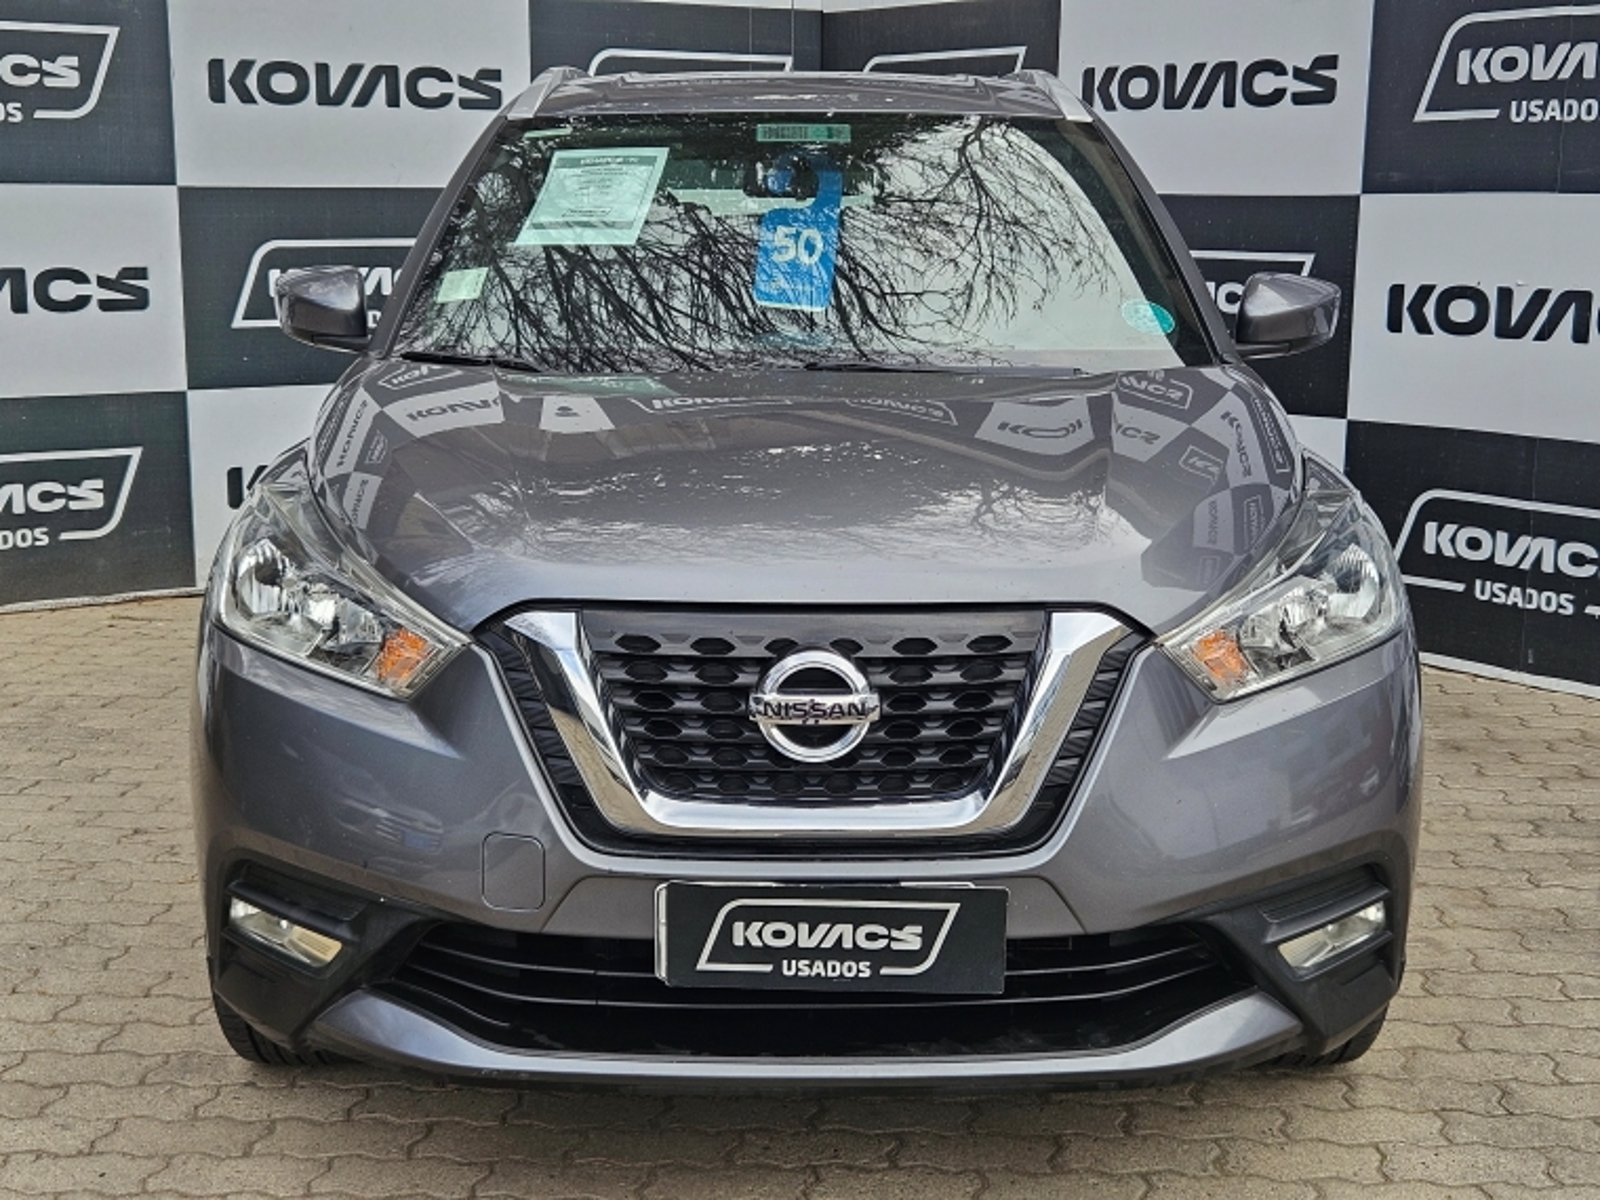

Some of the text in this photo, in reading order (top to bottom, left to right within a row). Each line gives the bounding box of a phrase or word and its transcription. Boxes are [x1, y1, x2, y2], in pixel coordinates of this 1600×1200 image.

[1456, 42, 1599, 85] KOVA
[208, 58, 503, 110] KOVACS
[1082, 54, 1339, 112] KOVACS
[1510, 98, 1599, 123] USADO
[772, 226, 823, 264] 50
[1387, 284, 1600, 344] KOVA
[1423, 521, 1600, 578] KOVAC
[1474, 579, 1575, 616] USADOS
[763, 702, 866, 718] NISSAN
[732, 921, 923, 950] KOVACS
[782, 959, 871, 978] USADOS
